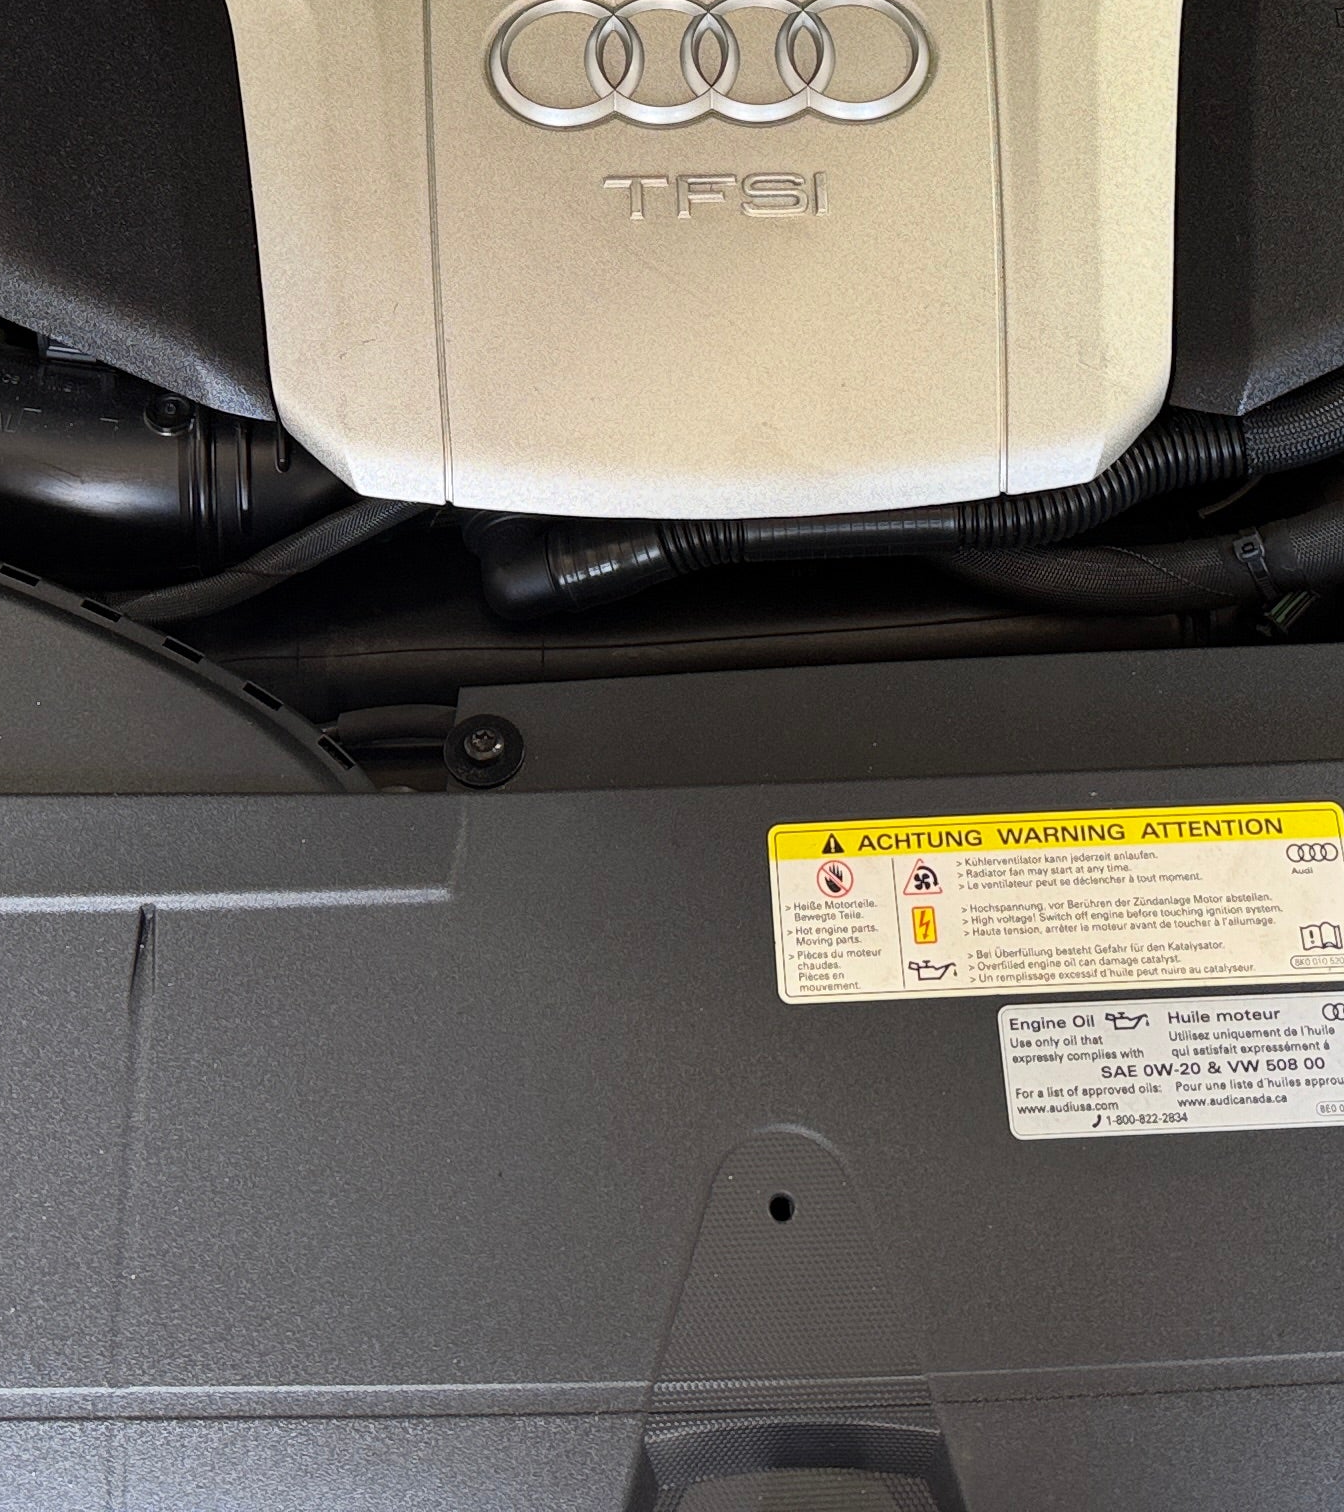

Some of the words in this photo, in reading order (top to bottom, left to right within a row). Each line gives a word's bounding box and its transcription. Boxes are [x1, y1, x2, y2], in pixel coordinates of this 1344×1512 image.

[603, 171, 830, 221] TFSI
[857, 829, 983, 851] ACHTUNG
[996, 823, 1125, 845] WARNING
[1141, 817, 1283, 839] ATTENTION
[1009, 1016, 1067, 1033] Engine
[1072, 1014, 1095, 1028] Oil
[1167, 1010, 1210, 1024] Huile
[1216, 1009, 1280, 1022] moteur
[1009, 1037, 1032, 1049] Use
[1034, 1036, 1060, 1048] only
[1062, 1034, 1078, 1046] oil
[1080, 1034, 1104, 1046] that
[1168, 1029, 1210, 1042] Utilisez
[1212, 1027, 1281, 1041] uniquement
[1283, 1026, 1298, 1037] de
[1012, 1051, 1064, 1066] expressly
[1066, 1048, 1117, 1063] complies
[1119, 1047, 1144, 1059] with
[1171, 1045, 1190, 1059] qui
[1192, 1043, 1238, 1056] satisfait
[1240, 1041, 1321, 1055] expressément
[1101, 1064, 1138, 1079] SAE
[1143, 1062, 1201, 1077] 0W-20
[1207, 1061, 1222, 1074] &
[1226, 1059, 1259, 1073] VW
[1265, 1057, 1298, 1072] 508
[1303, 1056, 1325, 1070] 00
[1015, 1088, 1034, 1099] For
[1037, 1089, 1044, 1099] a
[1046, 1086, 1065, 1098] list
[1066, 1085, 1079, 1097] of
[1081, 1083, 1136, 1098] approved
[1138, 1082, 1162, 1094] oils:
[1175, 1081, 1202, 1092] Pour
[1205, 1082, 1227, 1091] une
[1229, 1079, 1254, 1090] liste
[1016, 1101, 1119, 1114] www.audiusa.com
[1176, 1093, 1288, 1107] www.audicanada.ca
[1106, 1111, 1188, 1126] 1-800-822-2834
